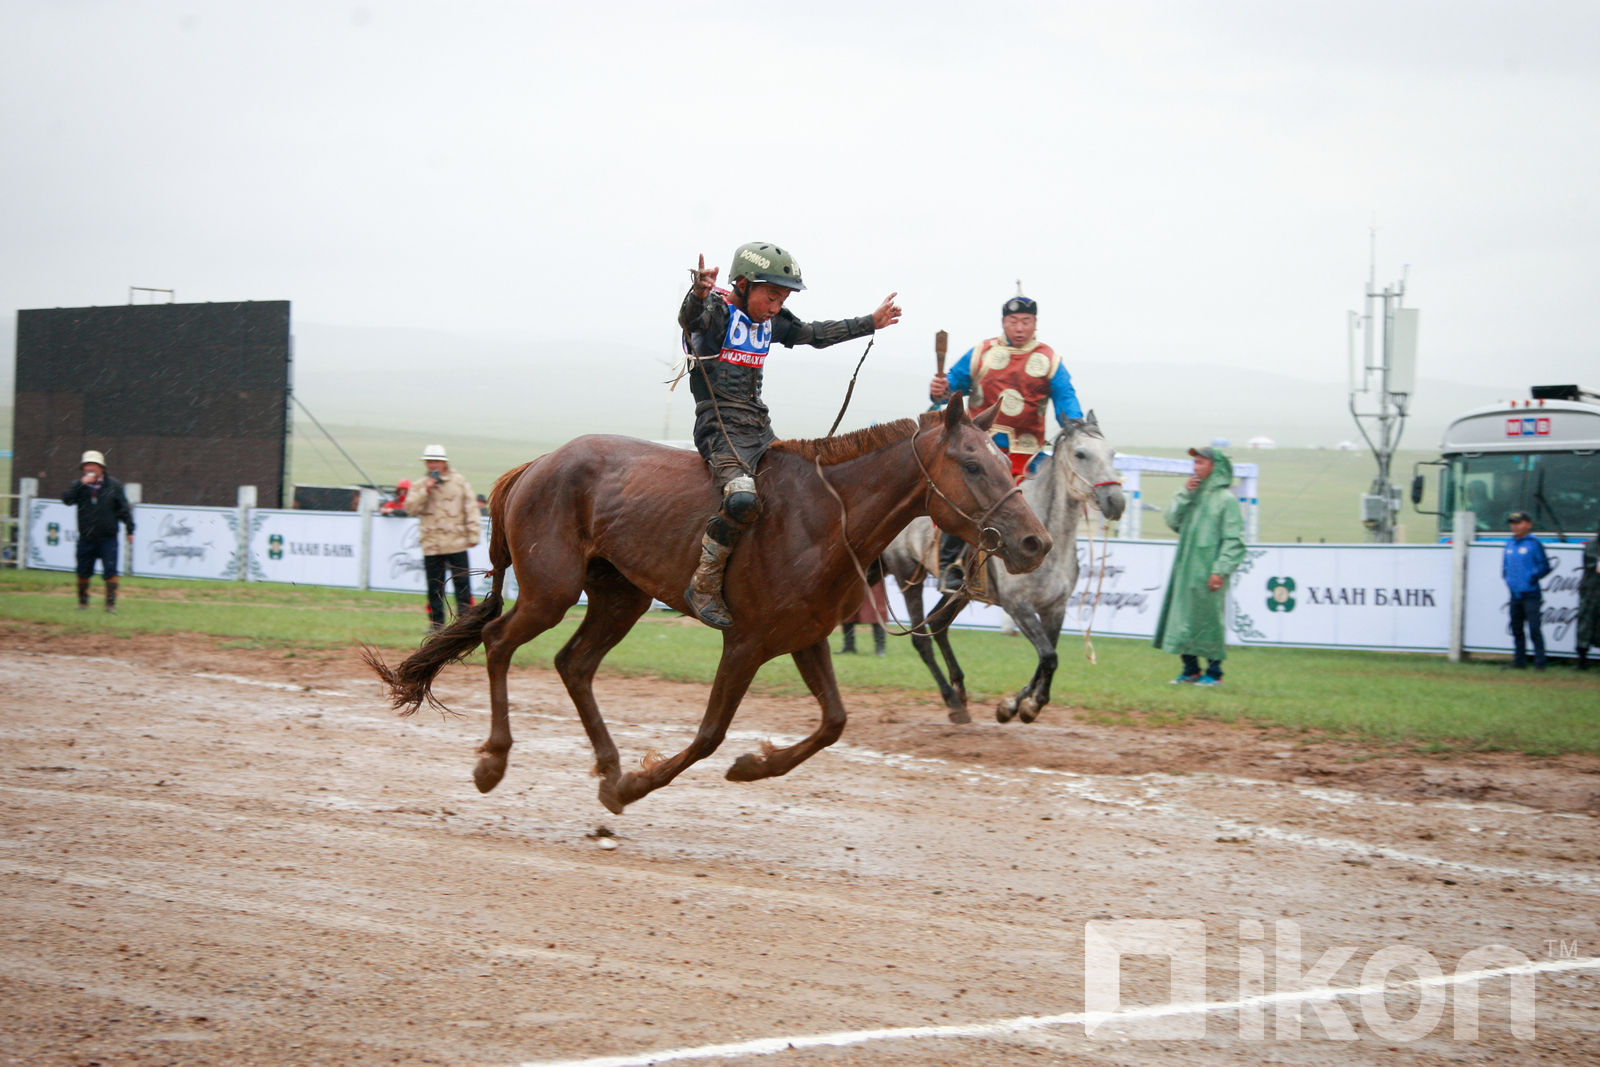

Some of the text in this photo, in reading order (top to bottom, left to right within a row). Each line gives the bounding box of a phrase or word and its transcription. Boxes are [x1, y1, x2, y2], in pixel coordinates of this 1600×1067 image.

[1506, 419, 1550, 435] MNB
[1306, 586, 1437, 607] ХААН БАНК
